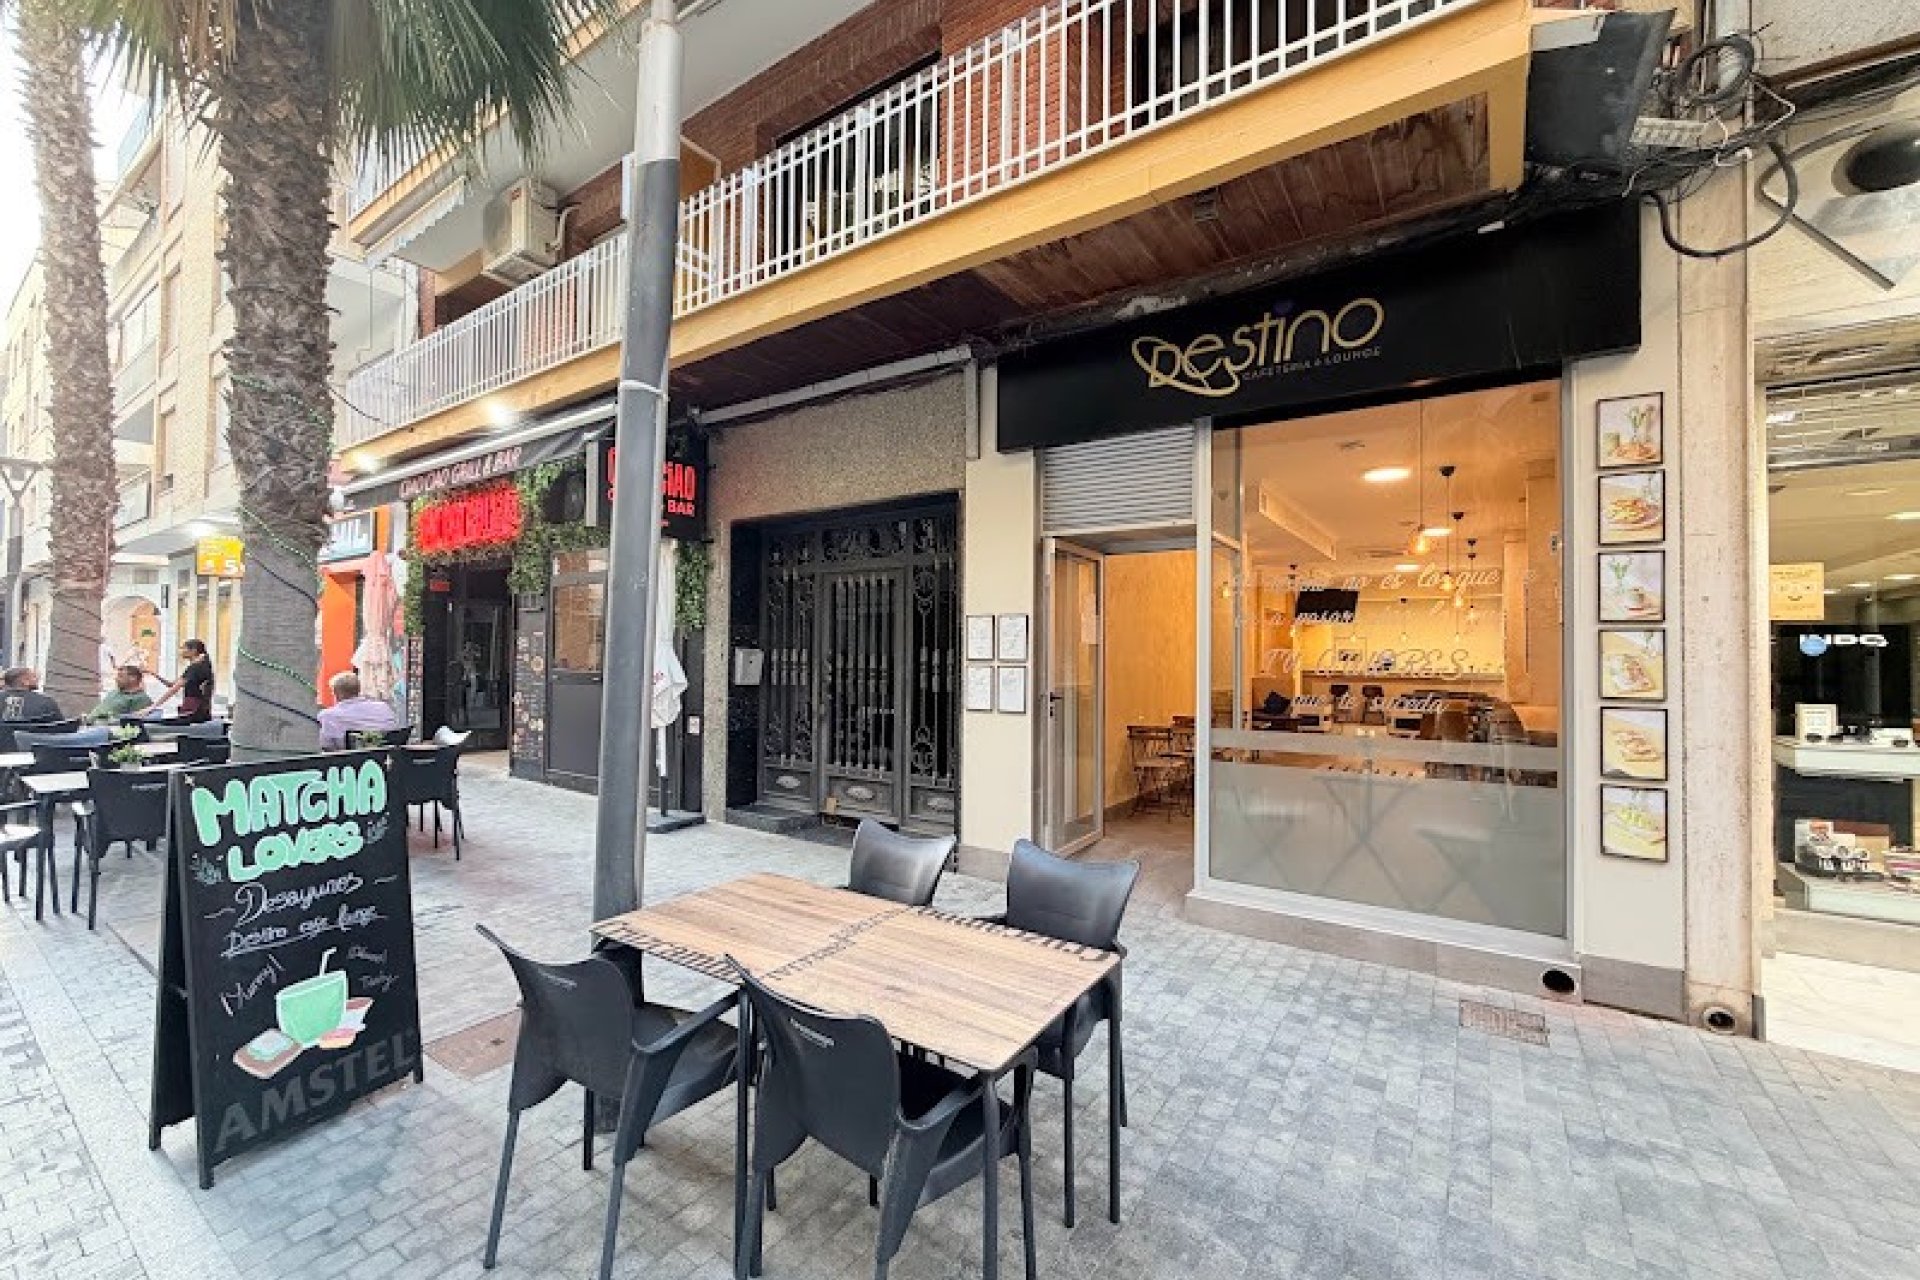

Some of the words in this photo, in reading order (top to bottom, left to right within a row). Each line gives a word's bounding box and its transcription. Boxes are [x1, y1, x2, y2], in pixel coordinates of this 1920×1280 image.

[1131, 297, 1385, 396] Destino
[1324, 346, 1382, 367] LOUNGE
[451, 458, 482, 484] GRILL
[494, 446, 522, 472] BAR
[667, 499, 696, 517] BAR
[191, 758, 387, 847] MATCHA
[227, 821, 364, 882] LOVERS
[214, 1041, 417, 1154] AMSTEL
